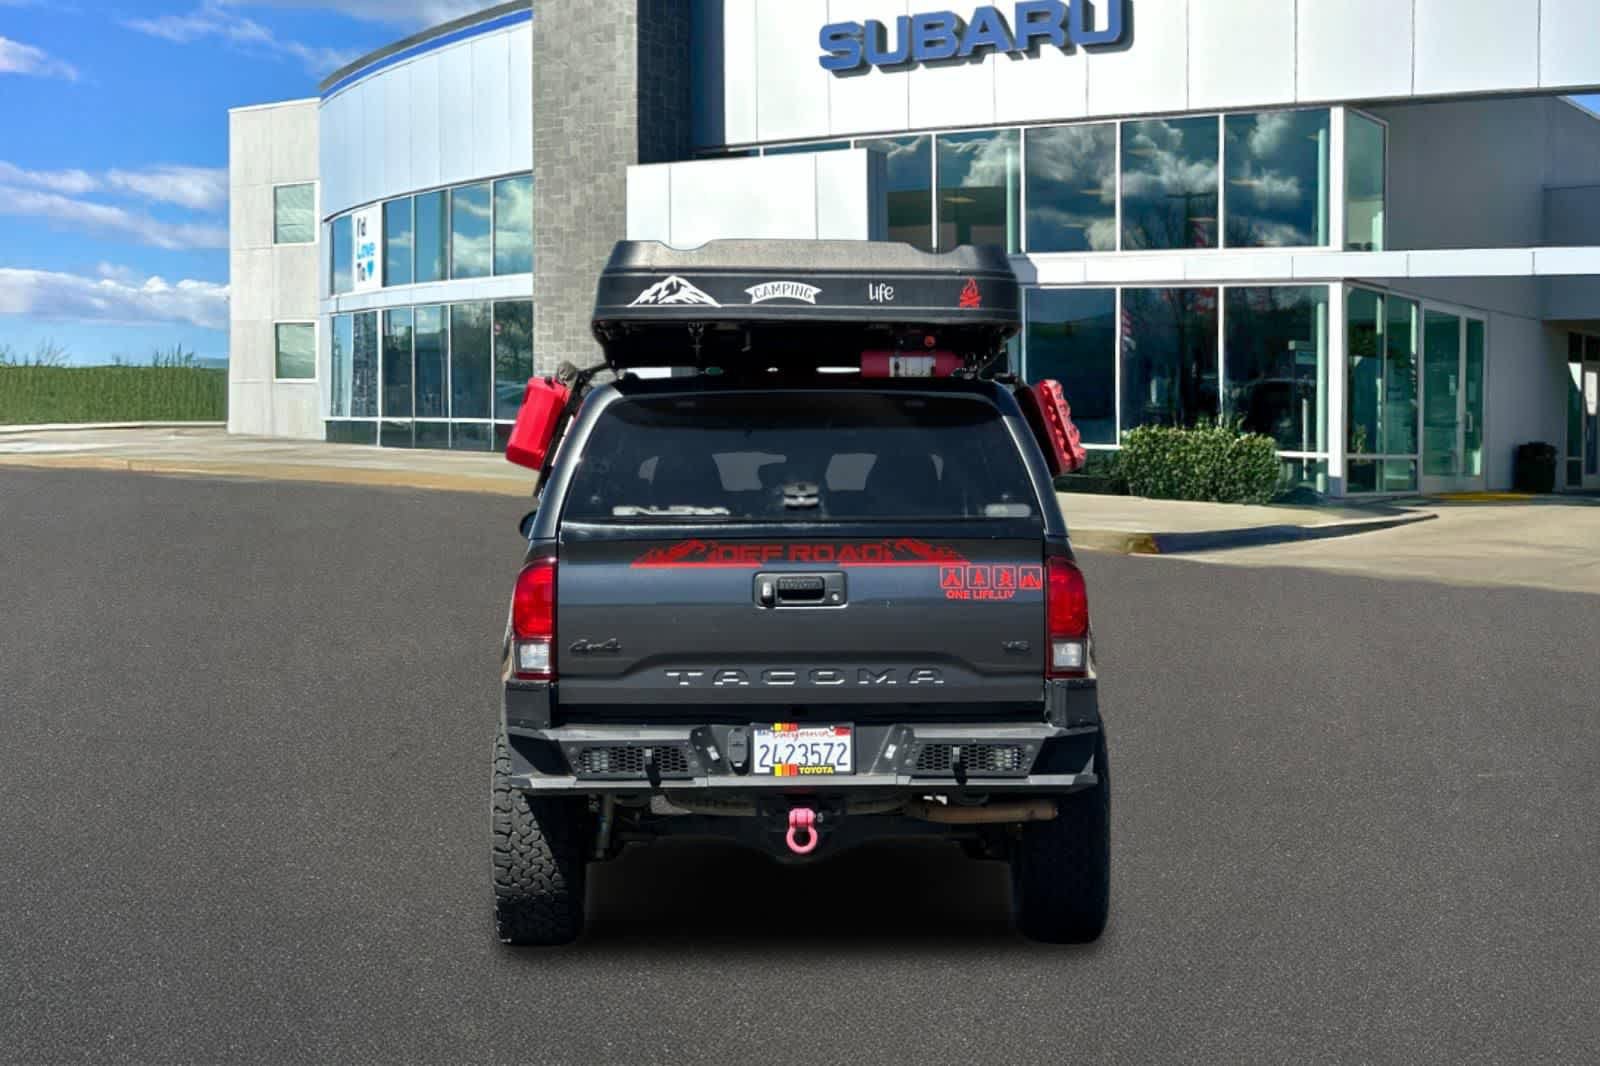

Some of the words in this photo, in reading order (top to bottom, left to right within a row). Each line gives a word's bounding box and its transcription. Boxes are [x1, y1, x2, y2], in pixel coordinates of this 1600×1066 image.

[818, 0, 1134, 78] SUBARU
[753, 283, 814, 300] CAMPING
[868, 282, 895, 303] Life
[718, 543, 783, 562] OFF
[788, 543, 886, 562] ROAD
[945, 590, 969, 600] ONE
[664, 668, 945, 686] TACOMA
[798, 765, 835, 775] TOYOTA
